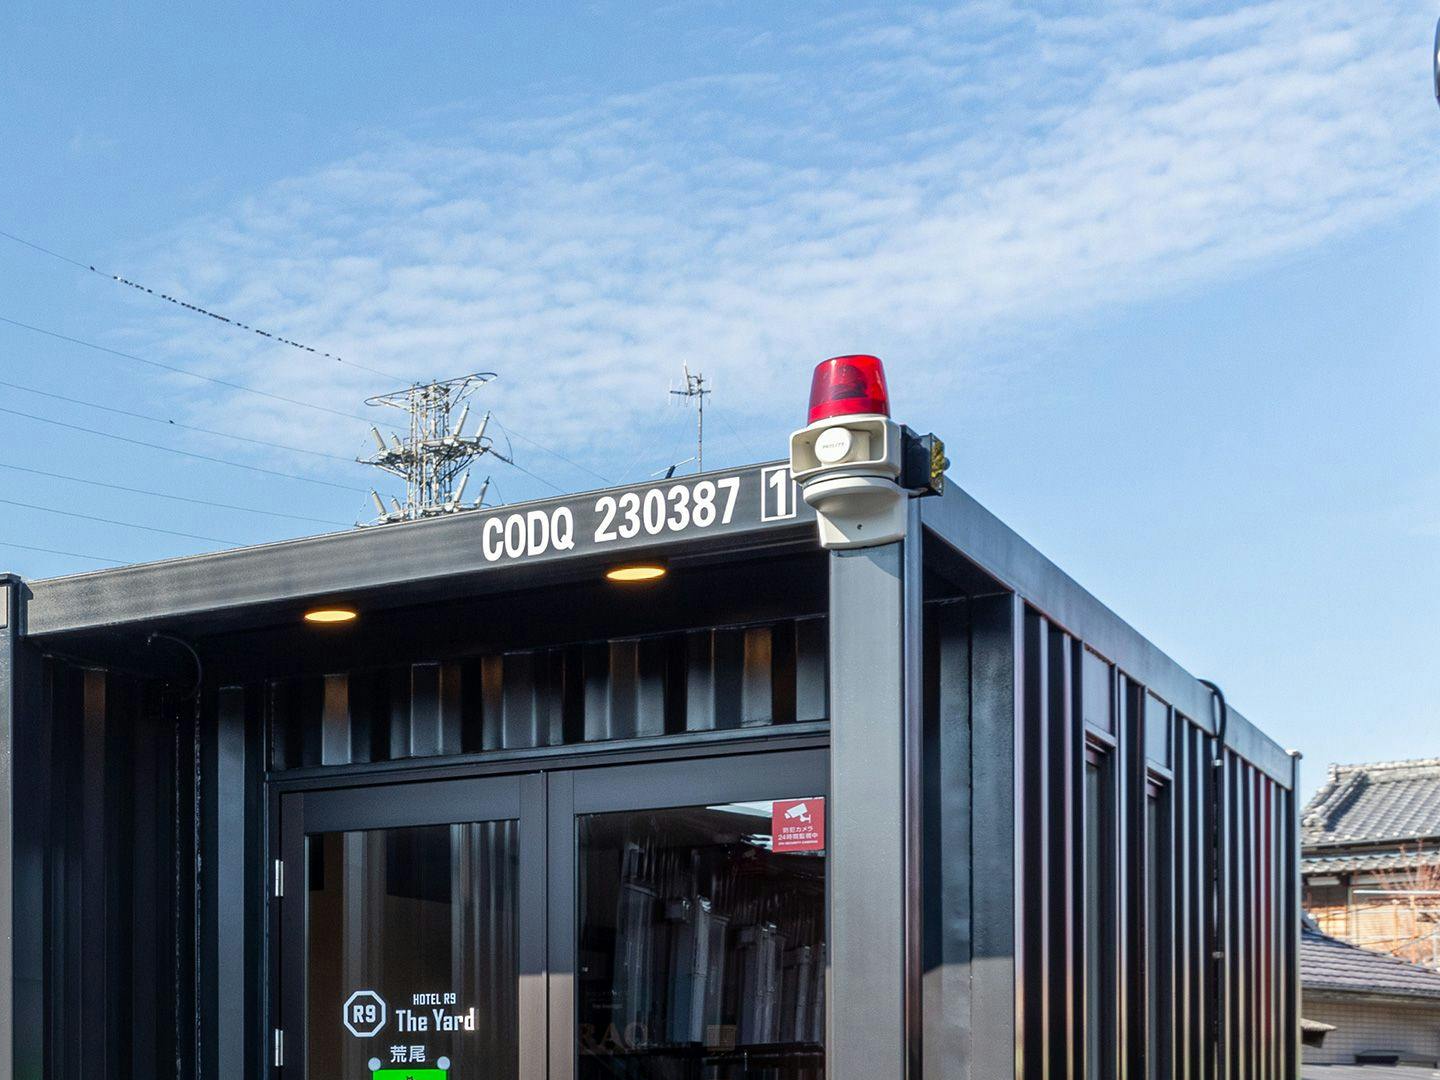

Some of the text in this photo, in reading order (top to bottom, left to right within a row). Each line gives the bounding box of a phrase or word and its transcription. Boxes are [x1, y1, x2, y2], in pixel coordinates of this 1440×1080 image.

[482, 467, 790, 562] CODQ 230387 1
[413, 992, 457, 1006] HOTEL R9
[353, 1004, 377, 1024] R9
[395, 1007, 475, 1032] The Yard
[390, 1045, 426, 1063] 荒尾
